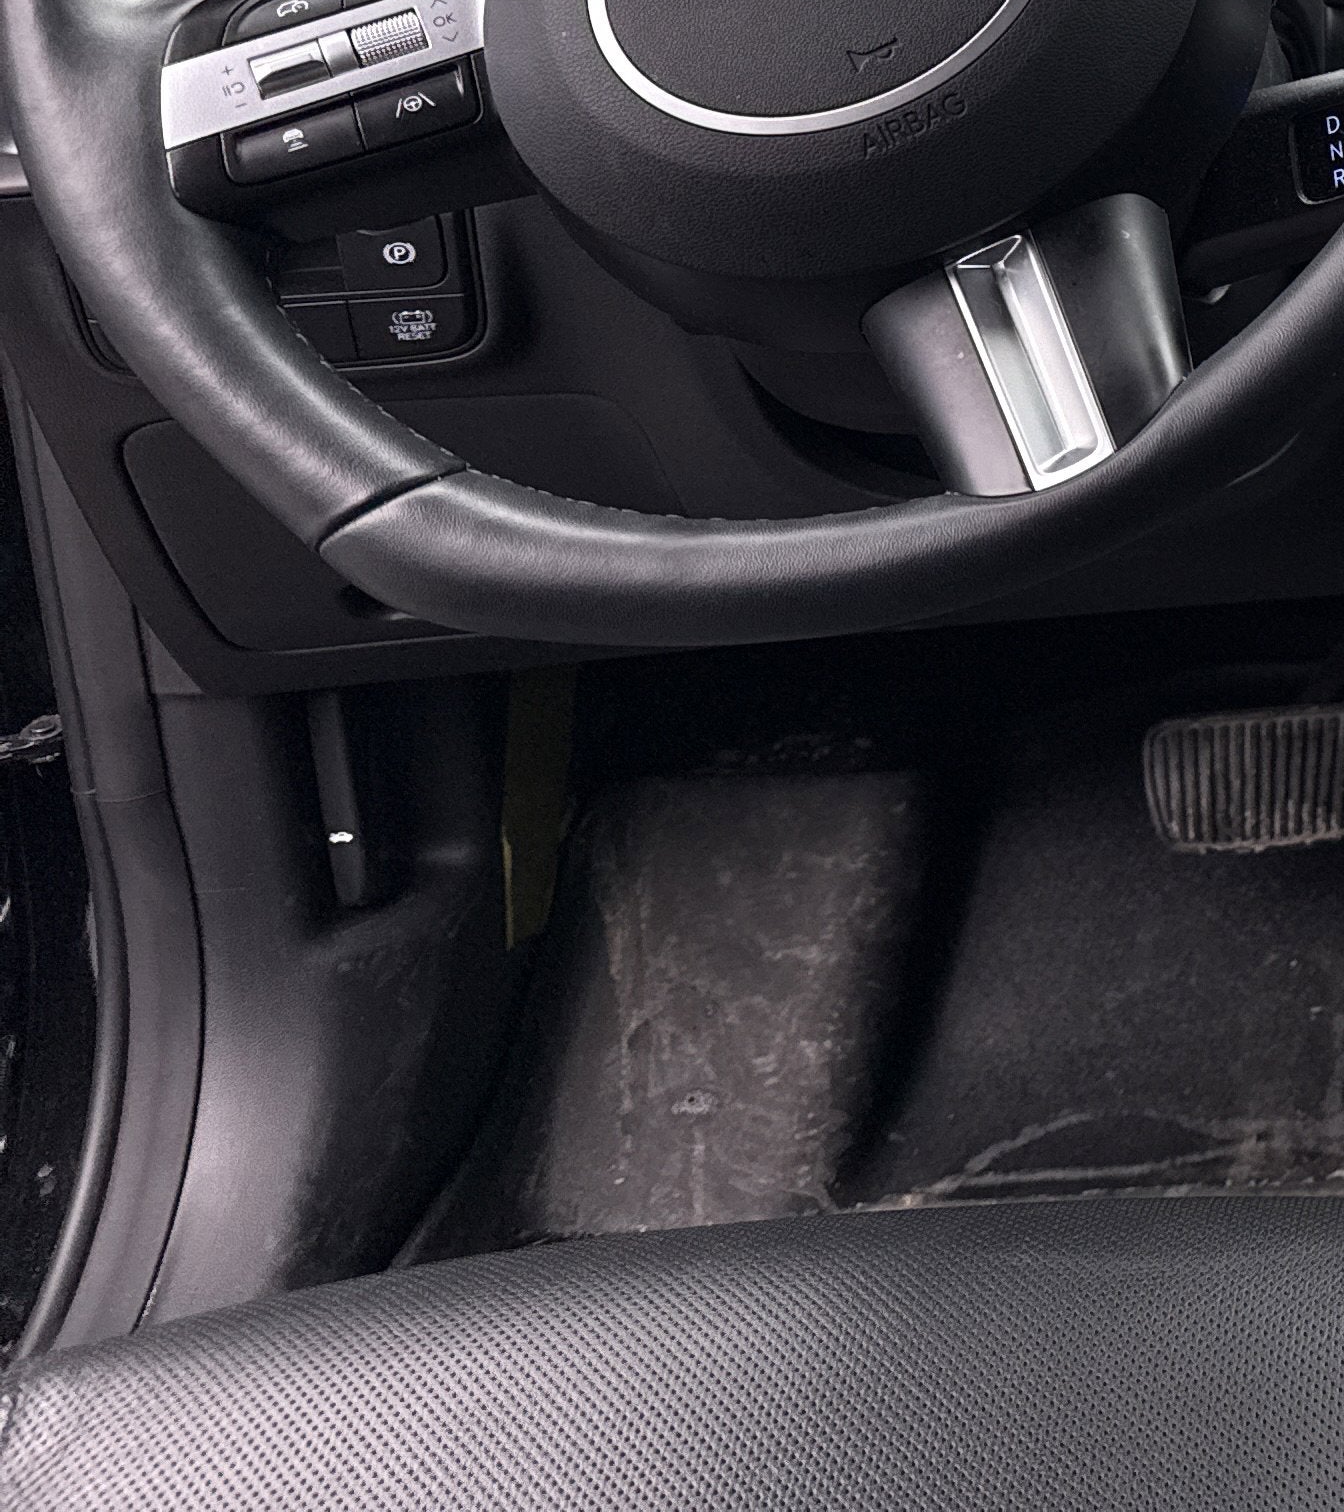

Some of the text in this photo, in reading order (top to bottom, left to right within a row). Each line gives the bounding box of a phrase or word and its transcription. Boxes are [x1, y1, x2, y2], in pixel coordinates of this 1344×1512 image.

[433, 12, 457, 28] OK
[861, 92, 969, 159] AIRBAG
[1326, 115, 1340, 136] D
[1329, 141, 1344, 161] N
